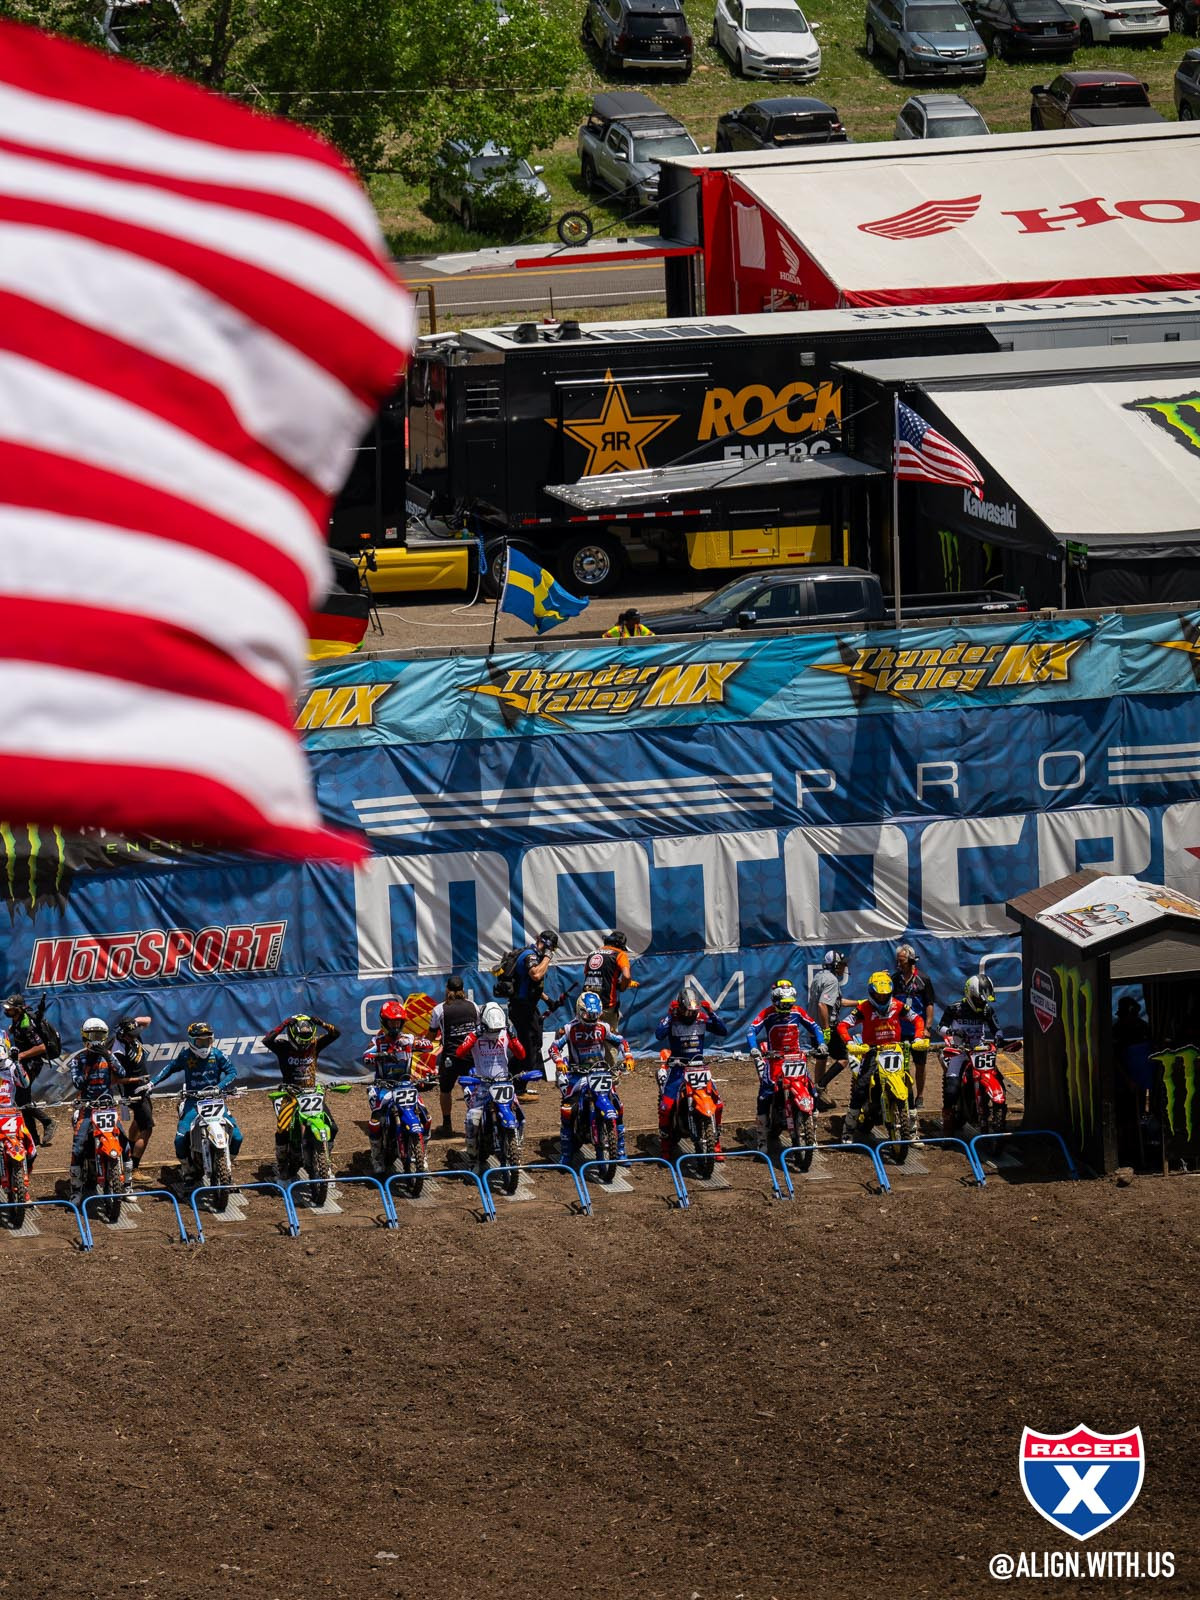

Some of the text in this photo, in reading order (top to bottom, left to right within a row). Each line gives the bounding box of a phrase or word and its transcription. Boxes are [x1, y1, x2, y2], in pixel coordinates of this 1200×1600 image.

[1000, 197, 1200, 234] HO
[963, 489, 1017, 529] Kawasaki
[852, 639, 1086, 687] Thunder MX
[503, 661, 745, 708] Thunder MX
[876, 666, 987, 692] Valley
[296, 683, 393, 729] MX
[527, 688, 640, 714] Valley
[796, 750, 1086, 808] PRO
[575, 1031, 603, 1041] FXR
[783, 1062, 806, 1076] 177
[883, 1055, 900, 1069] 11
[974, 1054, 996, 1069] 65
[589, 1075, 612, 1091] 75
[687, 1072, 708, 1088] 84
[395, 1089, 417, 1105] 23
[493, 1086, 513, 1100] 70
[200, 1104, 224, 1117] 27
[300, 1097, 322, 1112] 22
[1, 1117, 17, 1132] 4
[96, 1113, 116, 1128] 53
